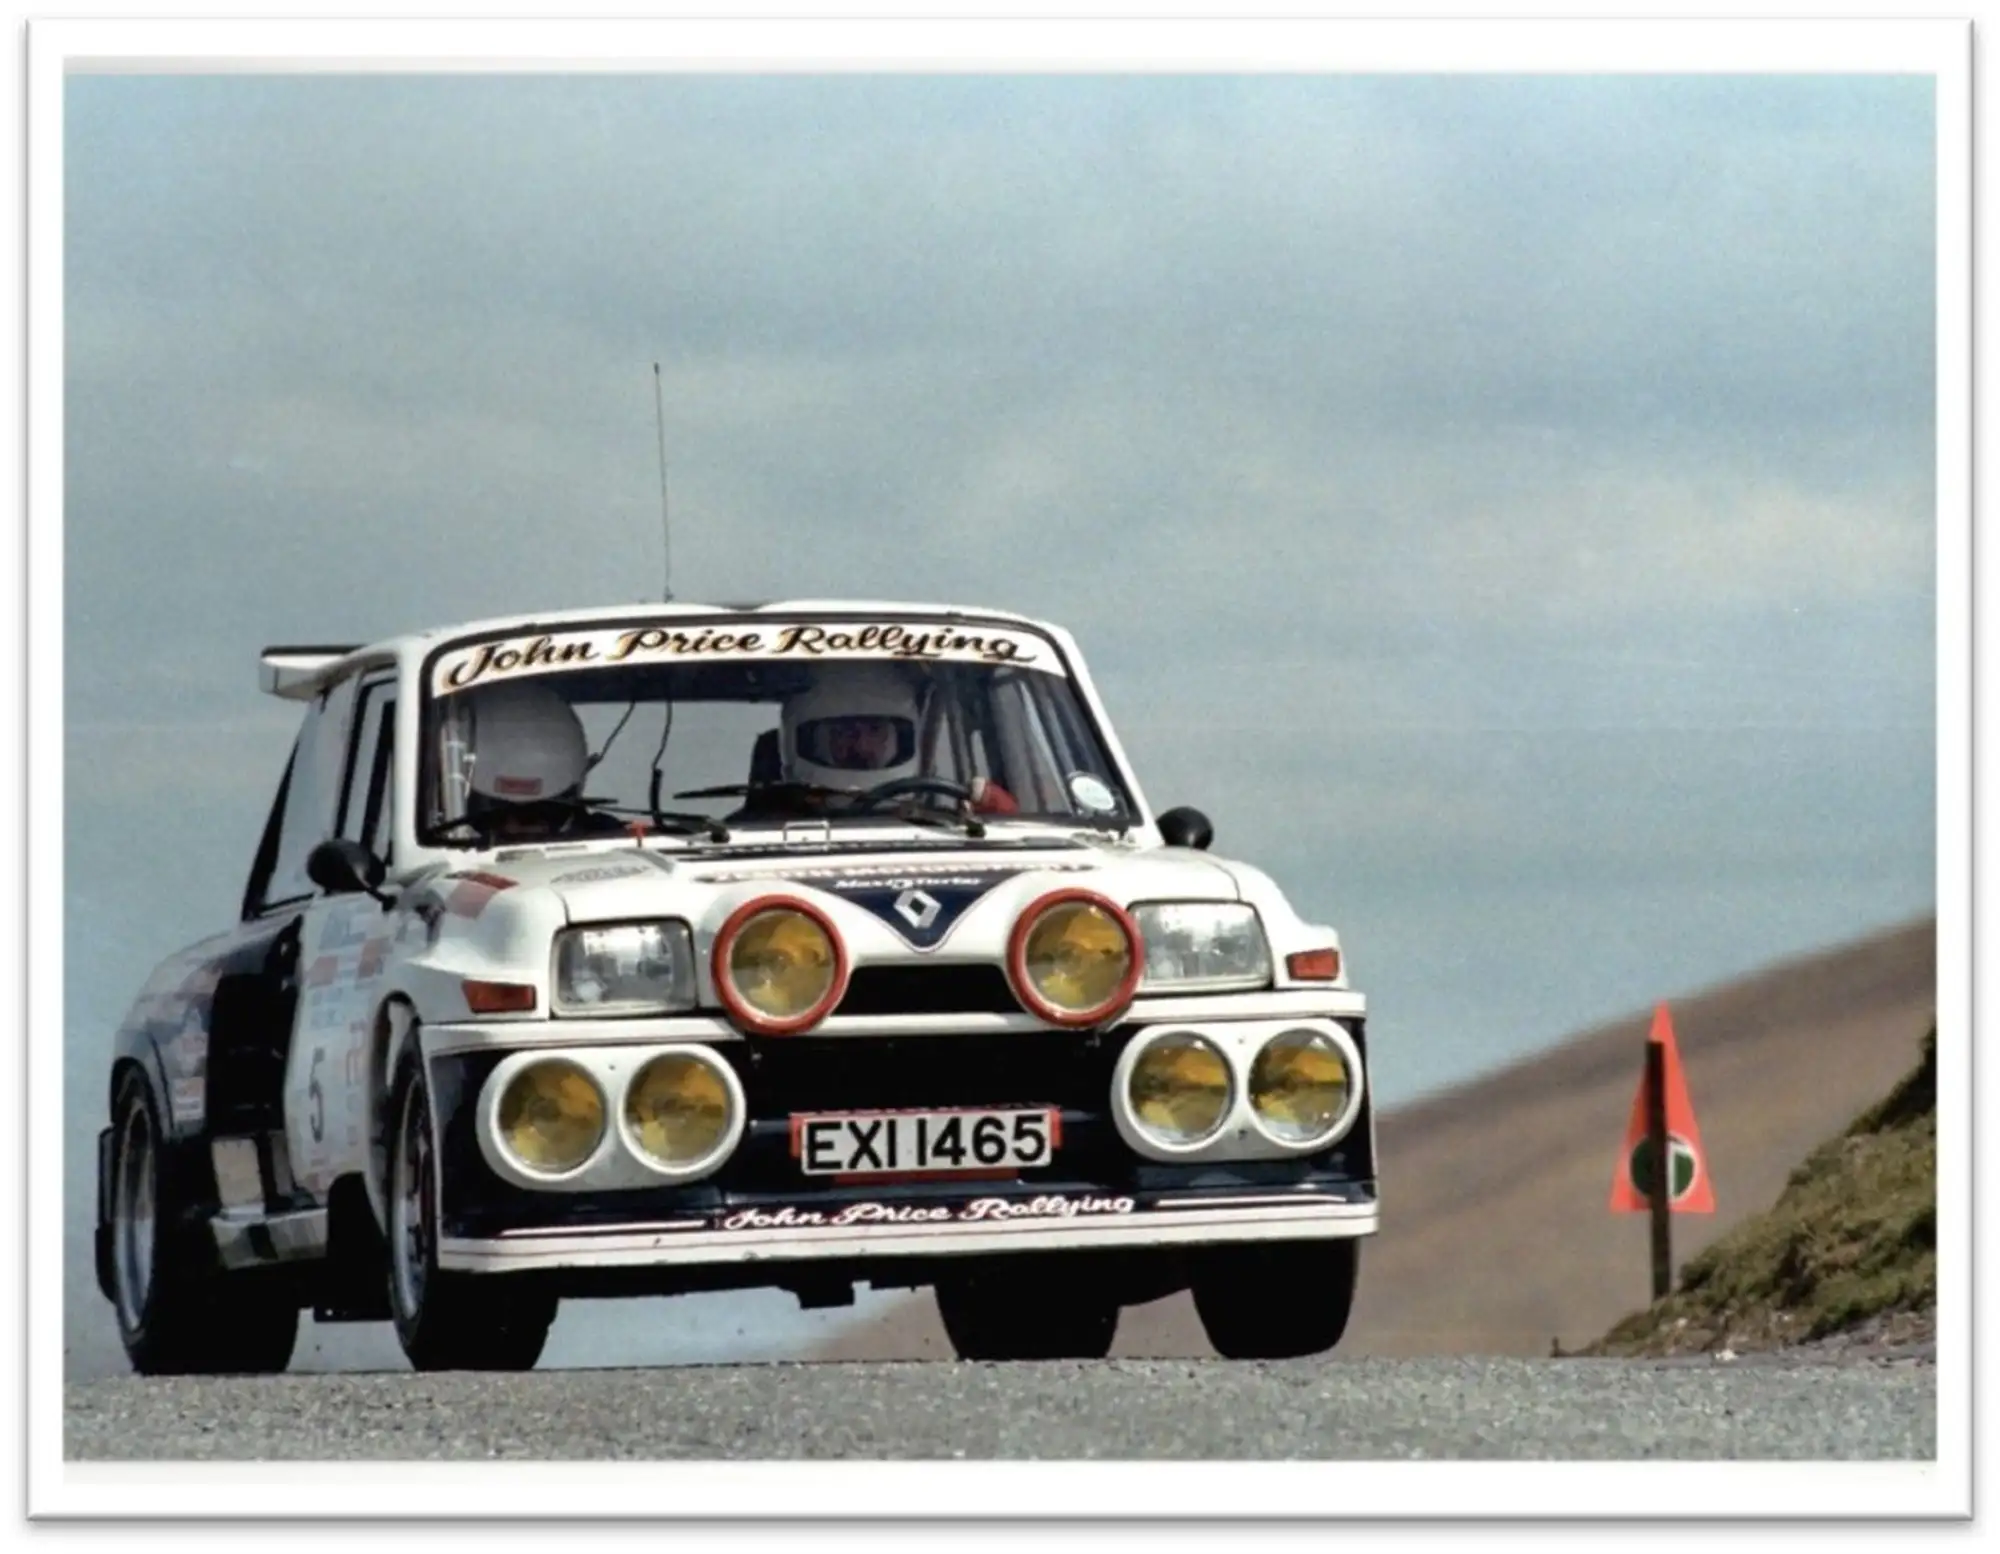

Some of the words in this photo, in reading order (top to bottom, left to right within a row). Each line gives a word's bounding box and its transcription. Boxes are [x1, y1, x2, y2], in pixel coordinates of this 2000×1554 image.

[443, 634, 600, 689] John
[605, 627, 764, 660] Price
[772, 625, 1037, 662] Rallying
[806, 1119, 897, 1170] EXI
[916, 1114, 1047, 1167] 1465
[723, 1207, 824, 1231] John
[830, 1202, 952, 1227] Price
[957, 1195, 1134, 1221] Rallying
